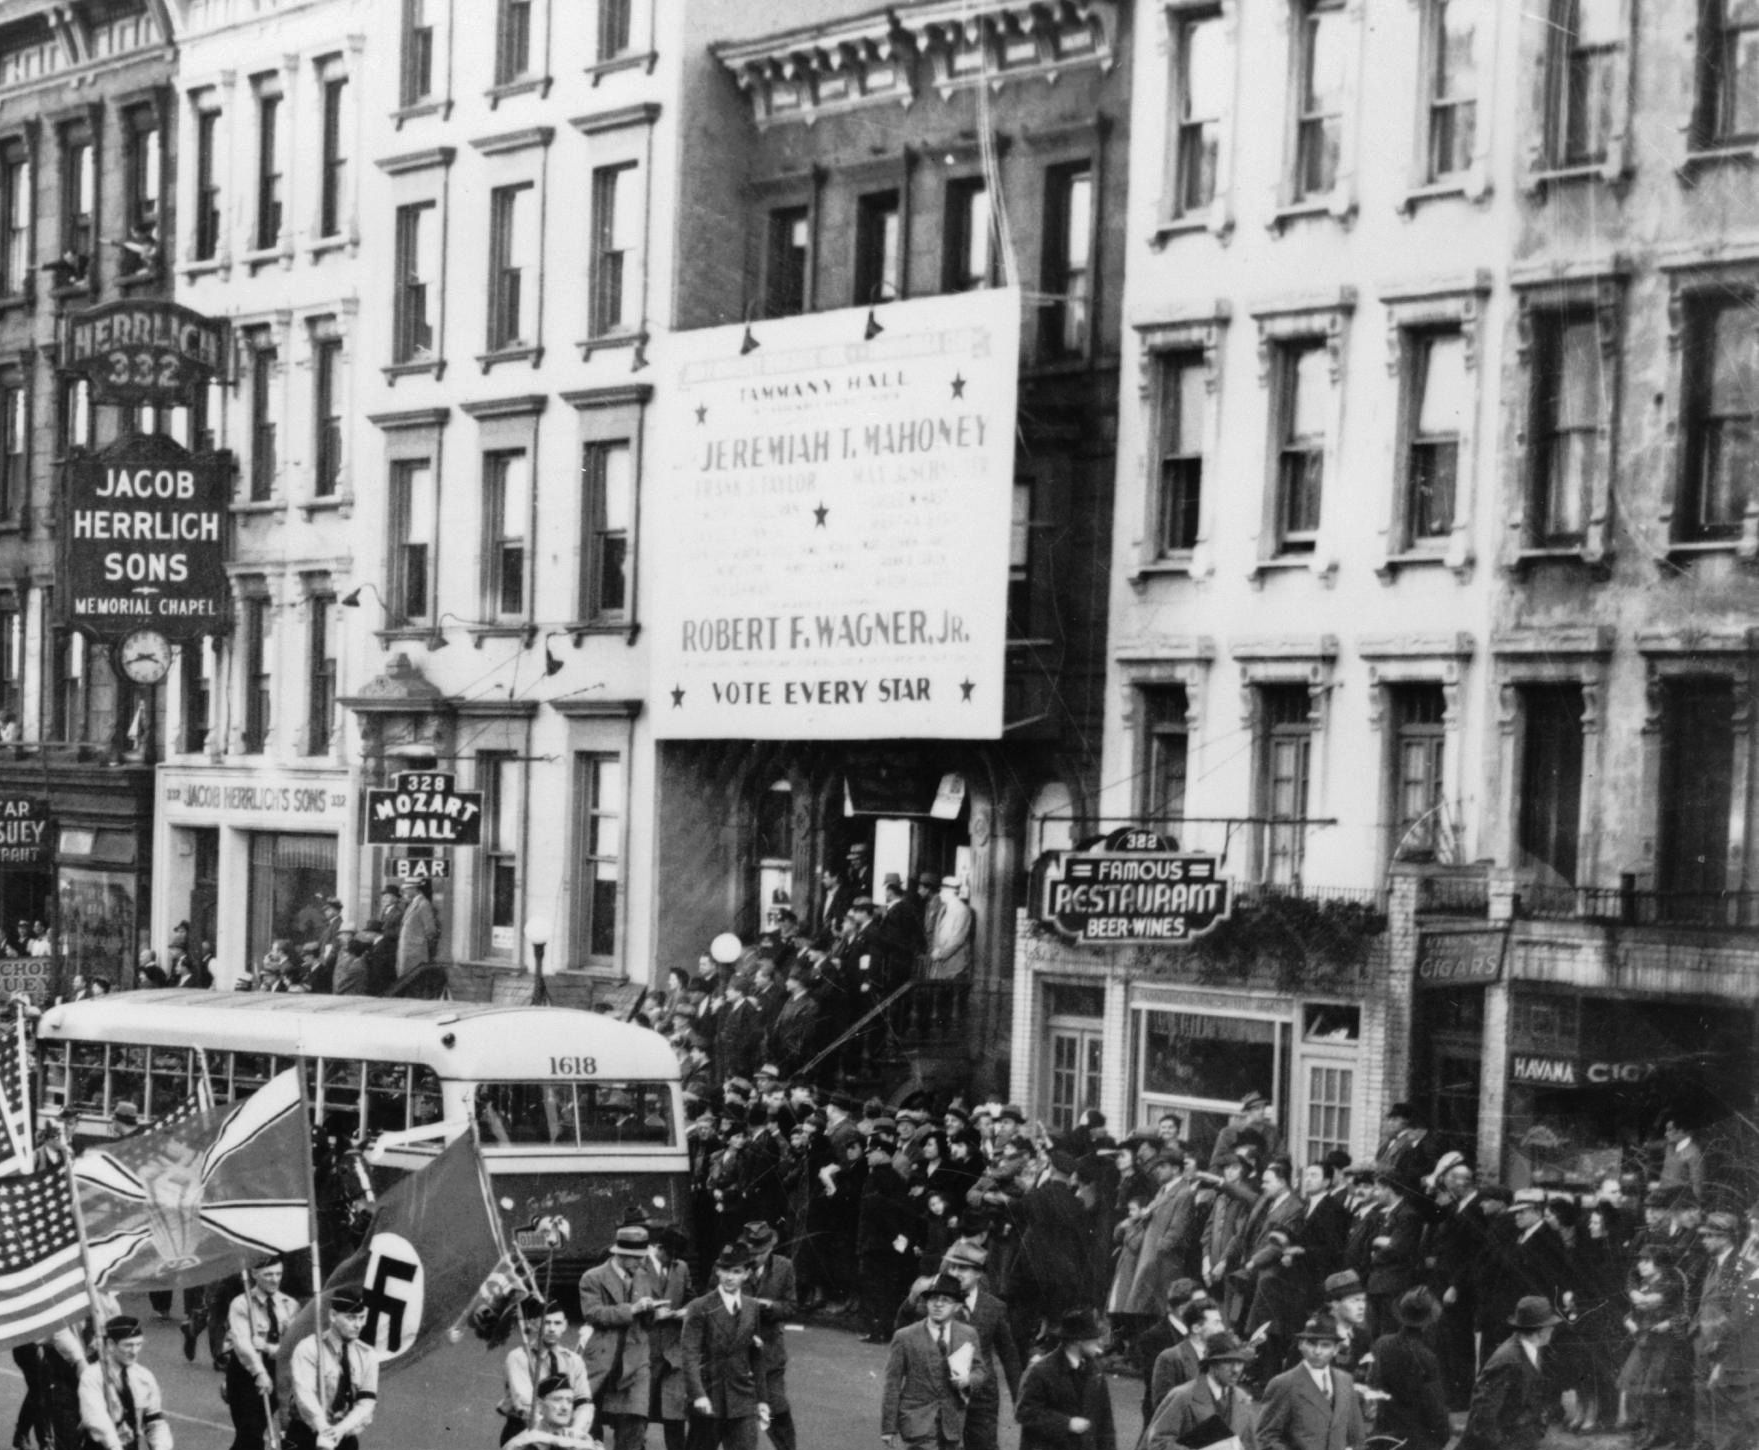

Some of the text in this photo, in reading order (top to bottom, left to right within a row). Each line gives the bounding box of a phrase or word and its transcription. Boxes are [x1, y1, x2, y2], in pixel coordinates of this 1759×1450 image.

[74, 312, 219, 364] HERRLICH
[108, 351, 182, 388] 332
[739, 369, 910, 402] TAMMANY HALL
[699, 413, 990, 473] JEREMIAH T. MAHONEY
[95, 469, 195, 499] JACOB
[73, 510, 219, 541] HERRLICH
[104, 552, 189, 582] SONS
[75, 597, 217, 616] MEMORIAL CHAPEL
[682, 616, 781, 652] ROBERT
[790, 615, 811, 650] F.
[712, 677, 932, 705] VOTE EVERY STAR
[408, 776, 445, 791] 328
[184, 784, 220, 809] JACOB
[293, 788, 327, 813] SONS
[374, 793, 479, 823] MOZART
[394, 817, 457, 839] HALL
[397, 859, 444, 877] BAR
[1098, 861, 1184, 882] FAMOUS
[1055, 884, 1222, 914] RESTAURANT
[1420, 955, 1498, 978] CIGARS
[549, 1057, 598, 1076] 1618
[1513, 1057, 1576, 1083] HAVANA
